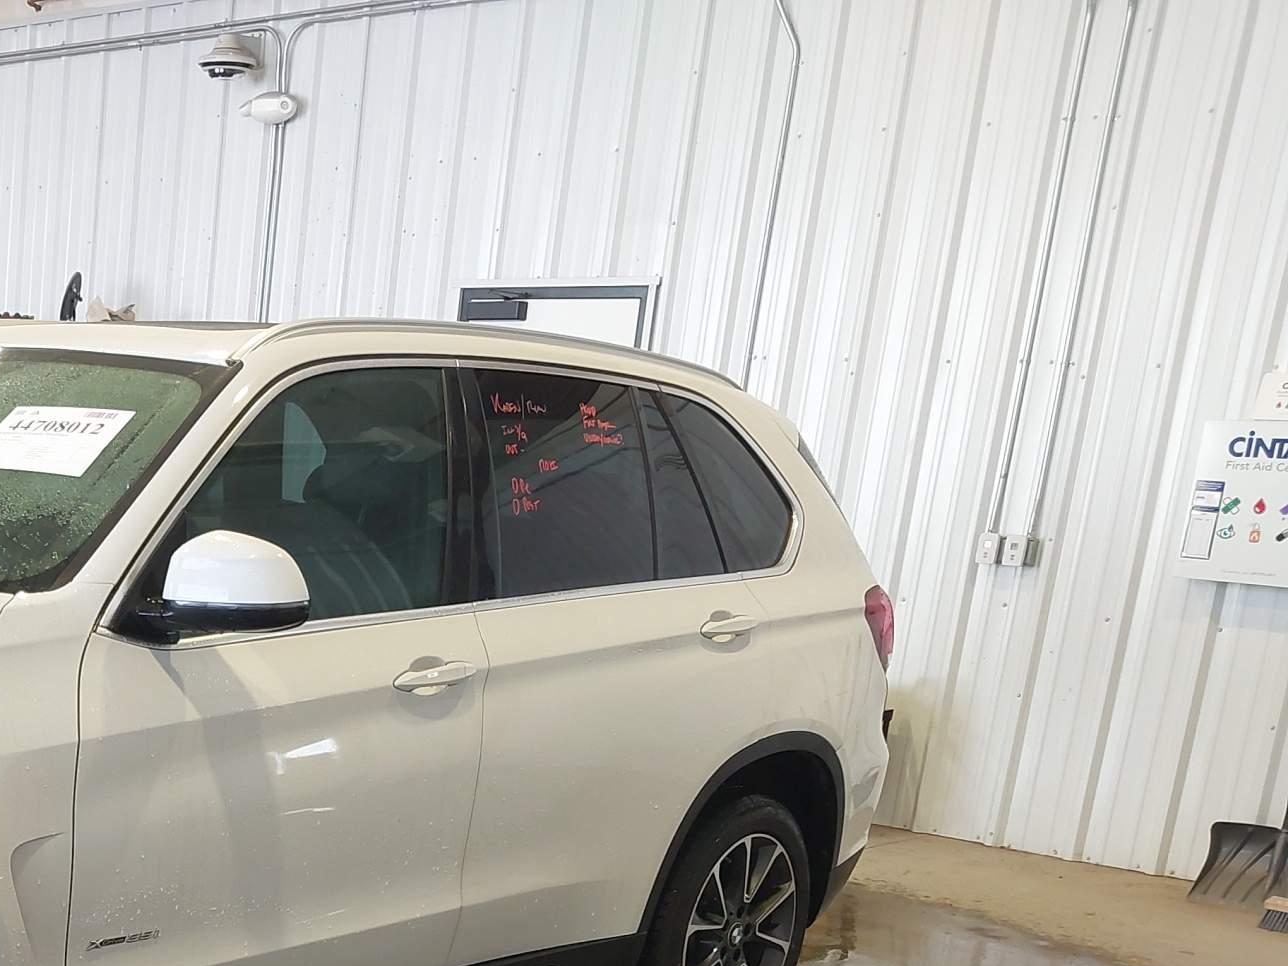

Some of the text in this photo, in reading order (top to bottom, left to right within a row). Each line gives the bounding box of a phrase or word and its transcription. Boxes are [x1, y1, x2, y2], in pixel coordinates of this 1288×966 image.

[9, 419, 106, 435] 44708012
[1225, 461, 1250, 471] First
[1253, 462, 1273, 472] Aid
